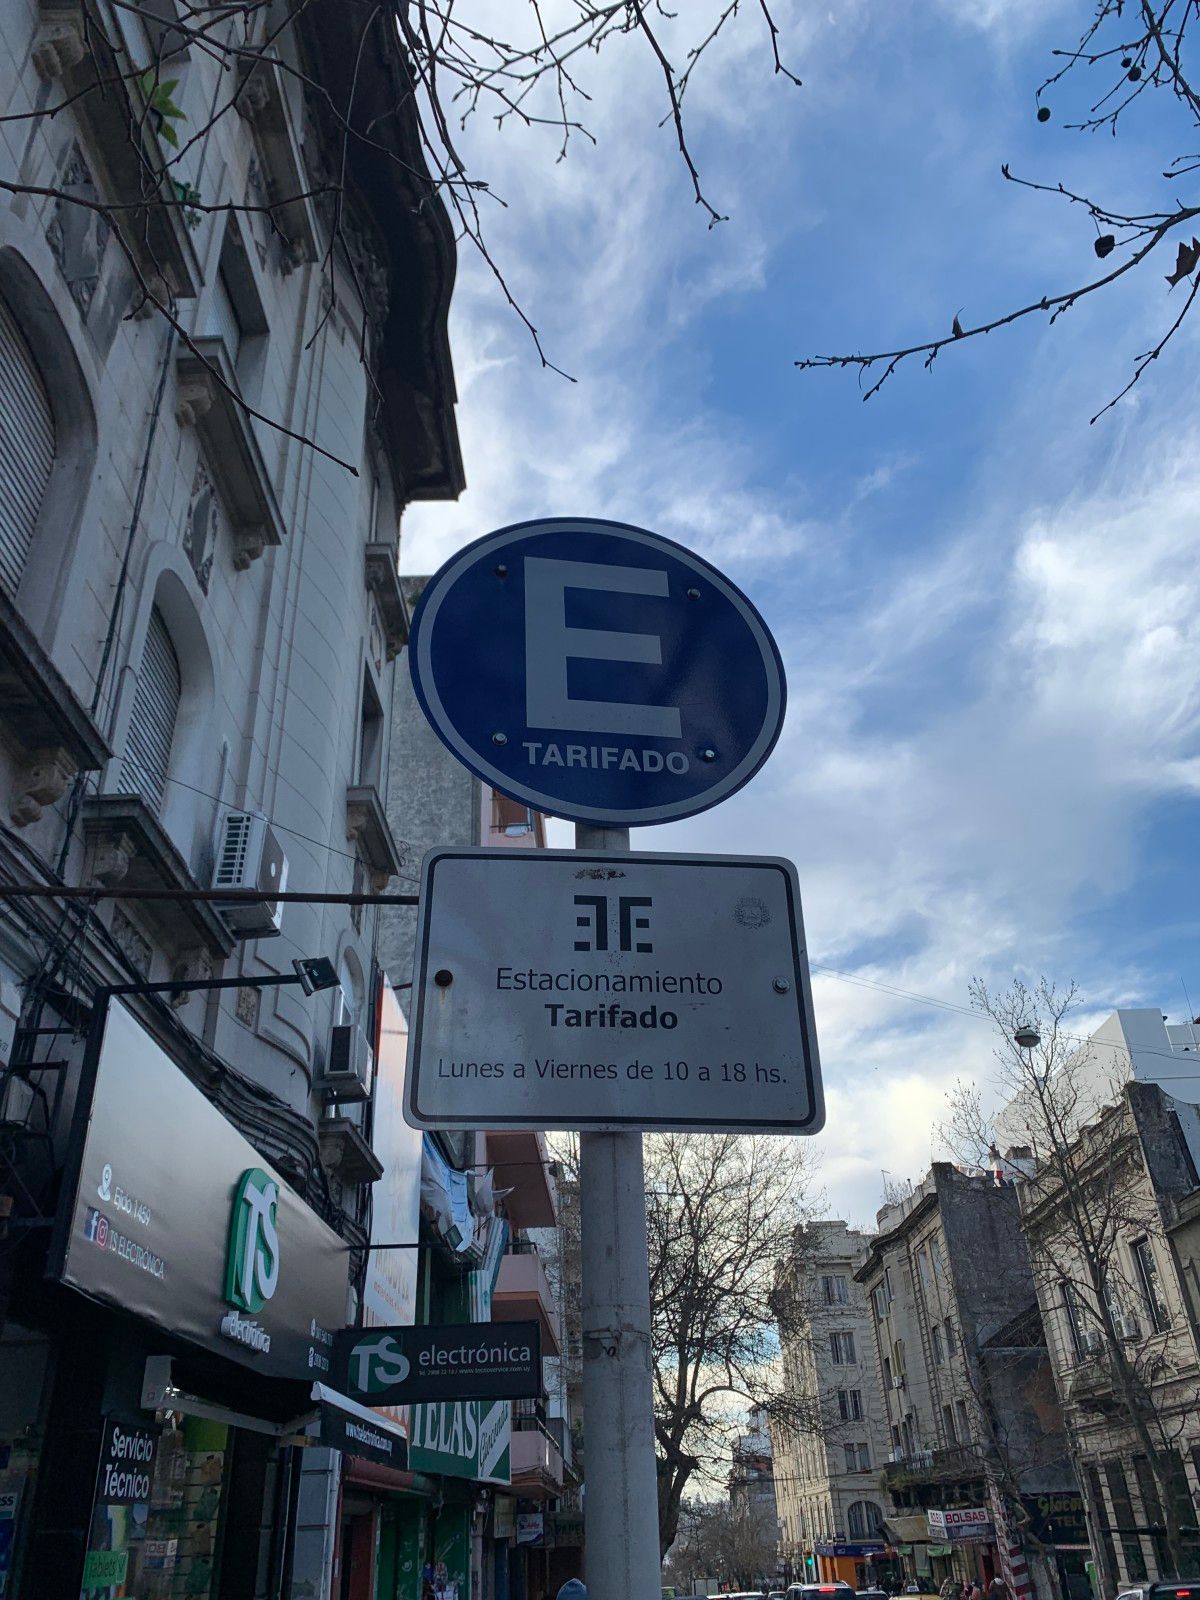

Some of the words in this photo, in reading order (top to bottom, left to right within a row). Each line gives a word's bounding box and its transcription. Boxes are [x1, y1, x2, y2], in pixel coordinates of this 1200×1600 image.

[524, 556, 682, 739] E
[522, 742, 690, 775] TARIFADO
[496, 967, 723, 995] Estacionamiento
[544, 1003, 678, 1029] Tarifado
[438, 1058, 504, 1079] Lunes
[513, 1065, 525, 1079] a
[534, 1060, 617, 1080] Viernes
[626, 1060, 653, 1080] de
[664, 1061, 688, 1081] 10
[698, 1066, 710, 1081] a
[720, 1062, 746, 1082] 18
[755, 1063, 788, 1084] hs.
[351, 1335, 410, 1393] TS
[419, 1342, 530, 1366] electrónica
[111, 1426, 153, 1462] Servicio
[411, 1401, 477, 1460] TELAS
[103, 1462, 150, 1499] Técnico
[945, 1511, 986, 1524] BOLSAS
